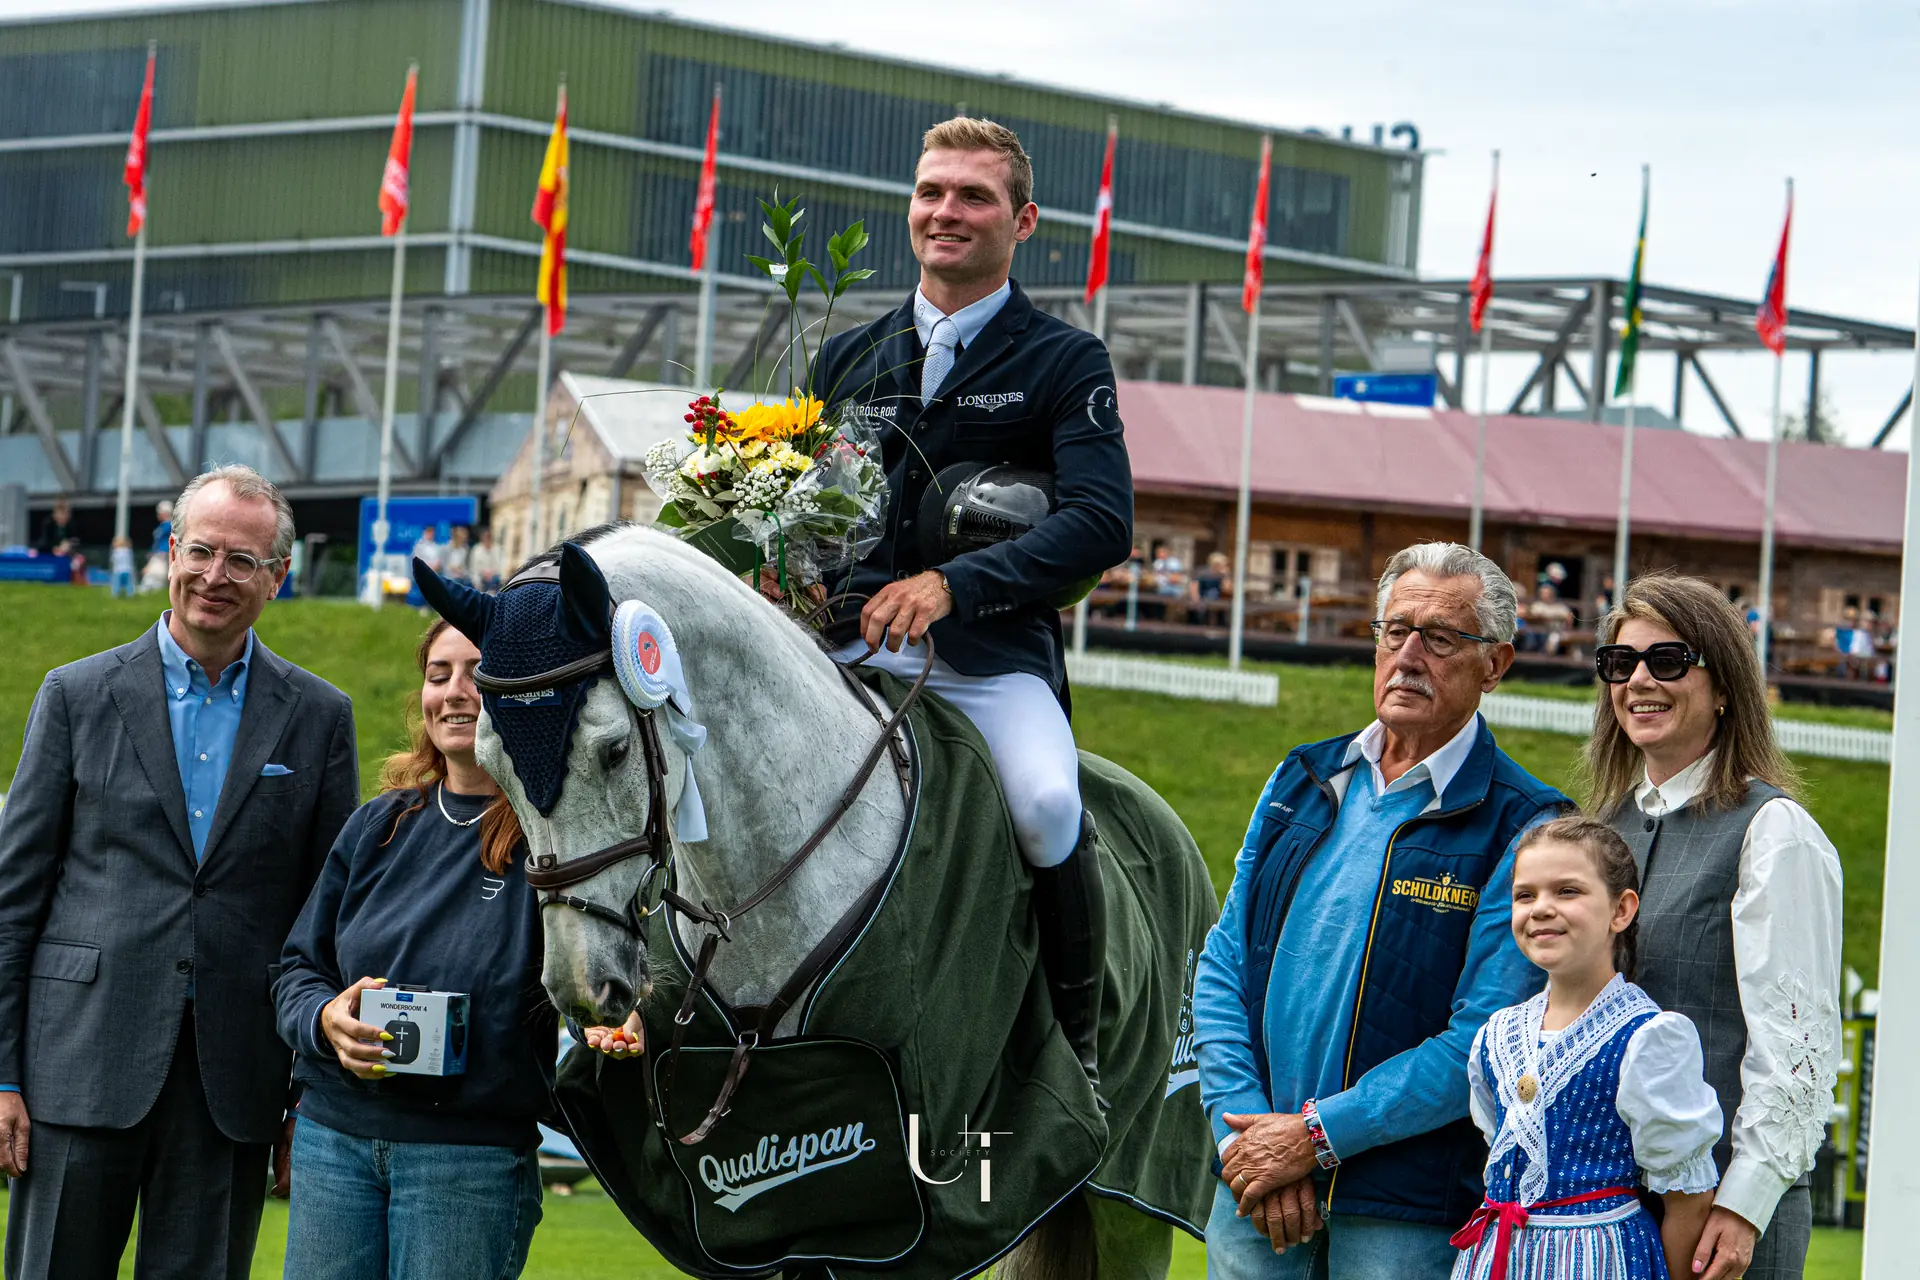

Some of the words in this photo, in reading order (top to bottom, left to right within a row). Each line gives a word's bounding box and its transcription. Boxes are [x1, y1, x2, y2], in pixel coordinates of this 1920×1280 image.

[957, 392, 1024, 406] LONGINES
[880, 405, 898, 417] ROIS
[380, 1002, 422, 1012] WONDERBOOM
[698, 1121, 876, 1195] Qualispan
